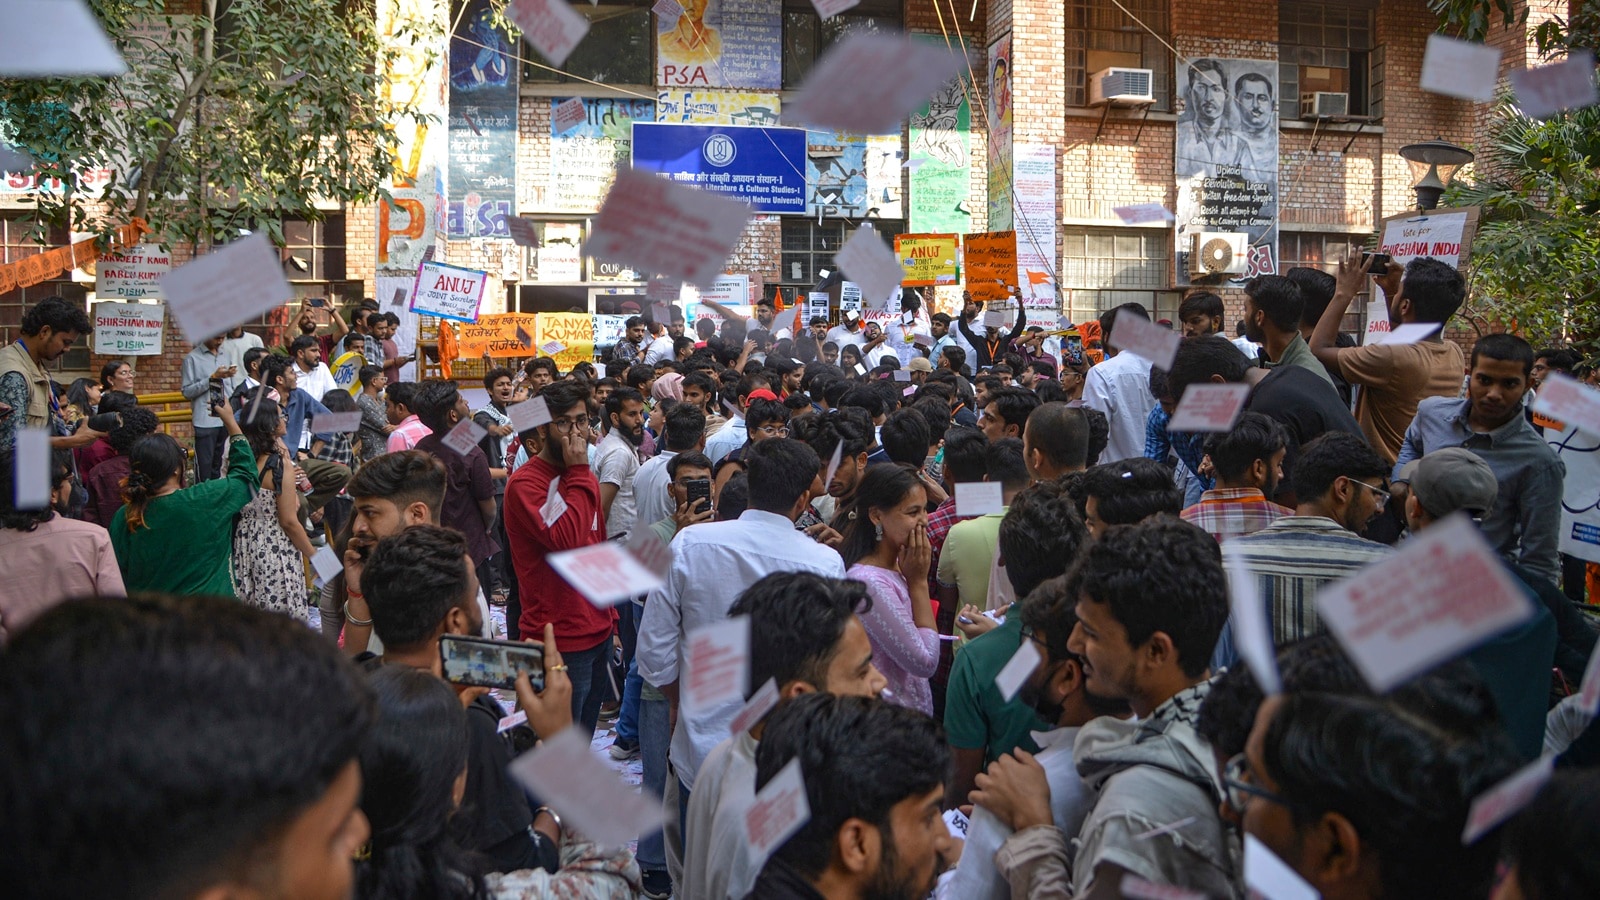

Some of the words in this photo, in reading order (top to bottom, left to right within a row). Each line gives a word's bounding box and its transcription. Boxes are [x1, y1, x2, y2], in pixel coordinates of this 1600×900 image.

[664, 65, 709, 84] PSA
[674, 171, 695, 181] साहित्य
[697, 172, 708, 181] और
[710, 172, 729, 184] संस्कृति
[732, 174, 755, 183] अध्ययन
[705, 184, 737, 192] Literature
[745, 185, 770, 193] Culture
[1247, 181, 1268, 194] Legacy
[752, 197, 771, 205] Nehru
[772, 197, 804, 207] University
[1251, 206, 1259, 215] to
[1403, 228, 1416, 238] Vote
[1417, 227, 1432, 238] for
[911, 246, 941, 258] ANUJ
[1431, 242, 1460, 256] INDU
[147, 256, 169, 266] KAUR
[424, 265, 440, 273] VOTE
[434, 274, 476, 294] ANUJ
[117, 288, 147, 297] DISHA
[427, 291, 448, 301] JOINT
[97, 316, 145, 329] SHIRSHAVA
[145, 320, 163, 329] INDU
[544, 316, 594, 330] TANYA
[115, 330, 136, 338] JNUSU
[465, 326, 502, 338] राजेश्वर
[116, 340, 145, 349] DISHA
